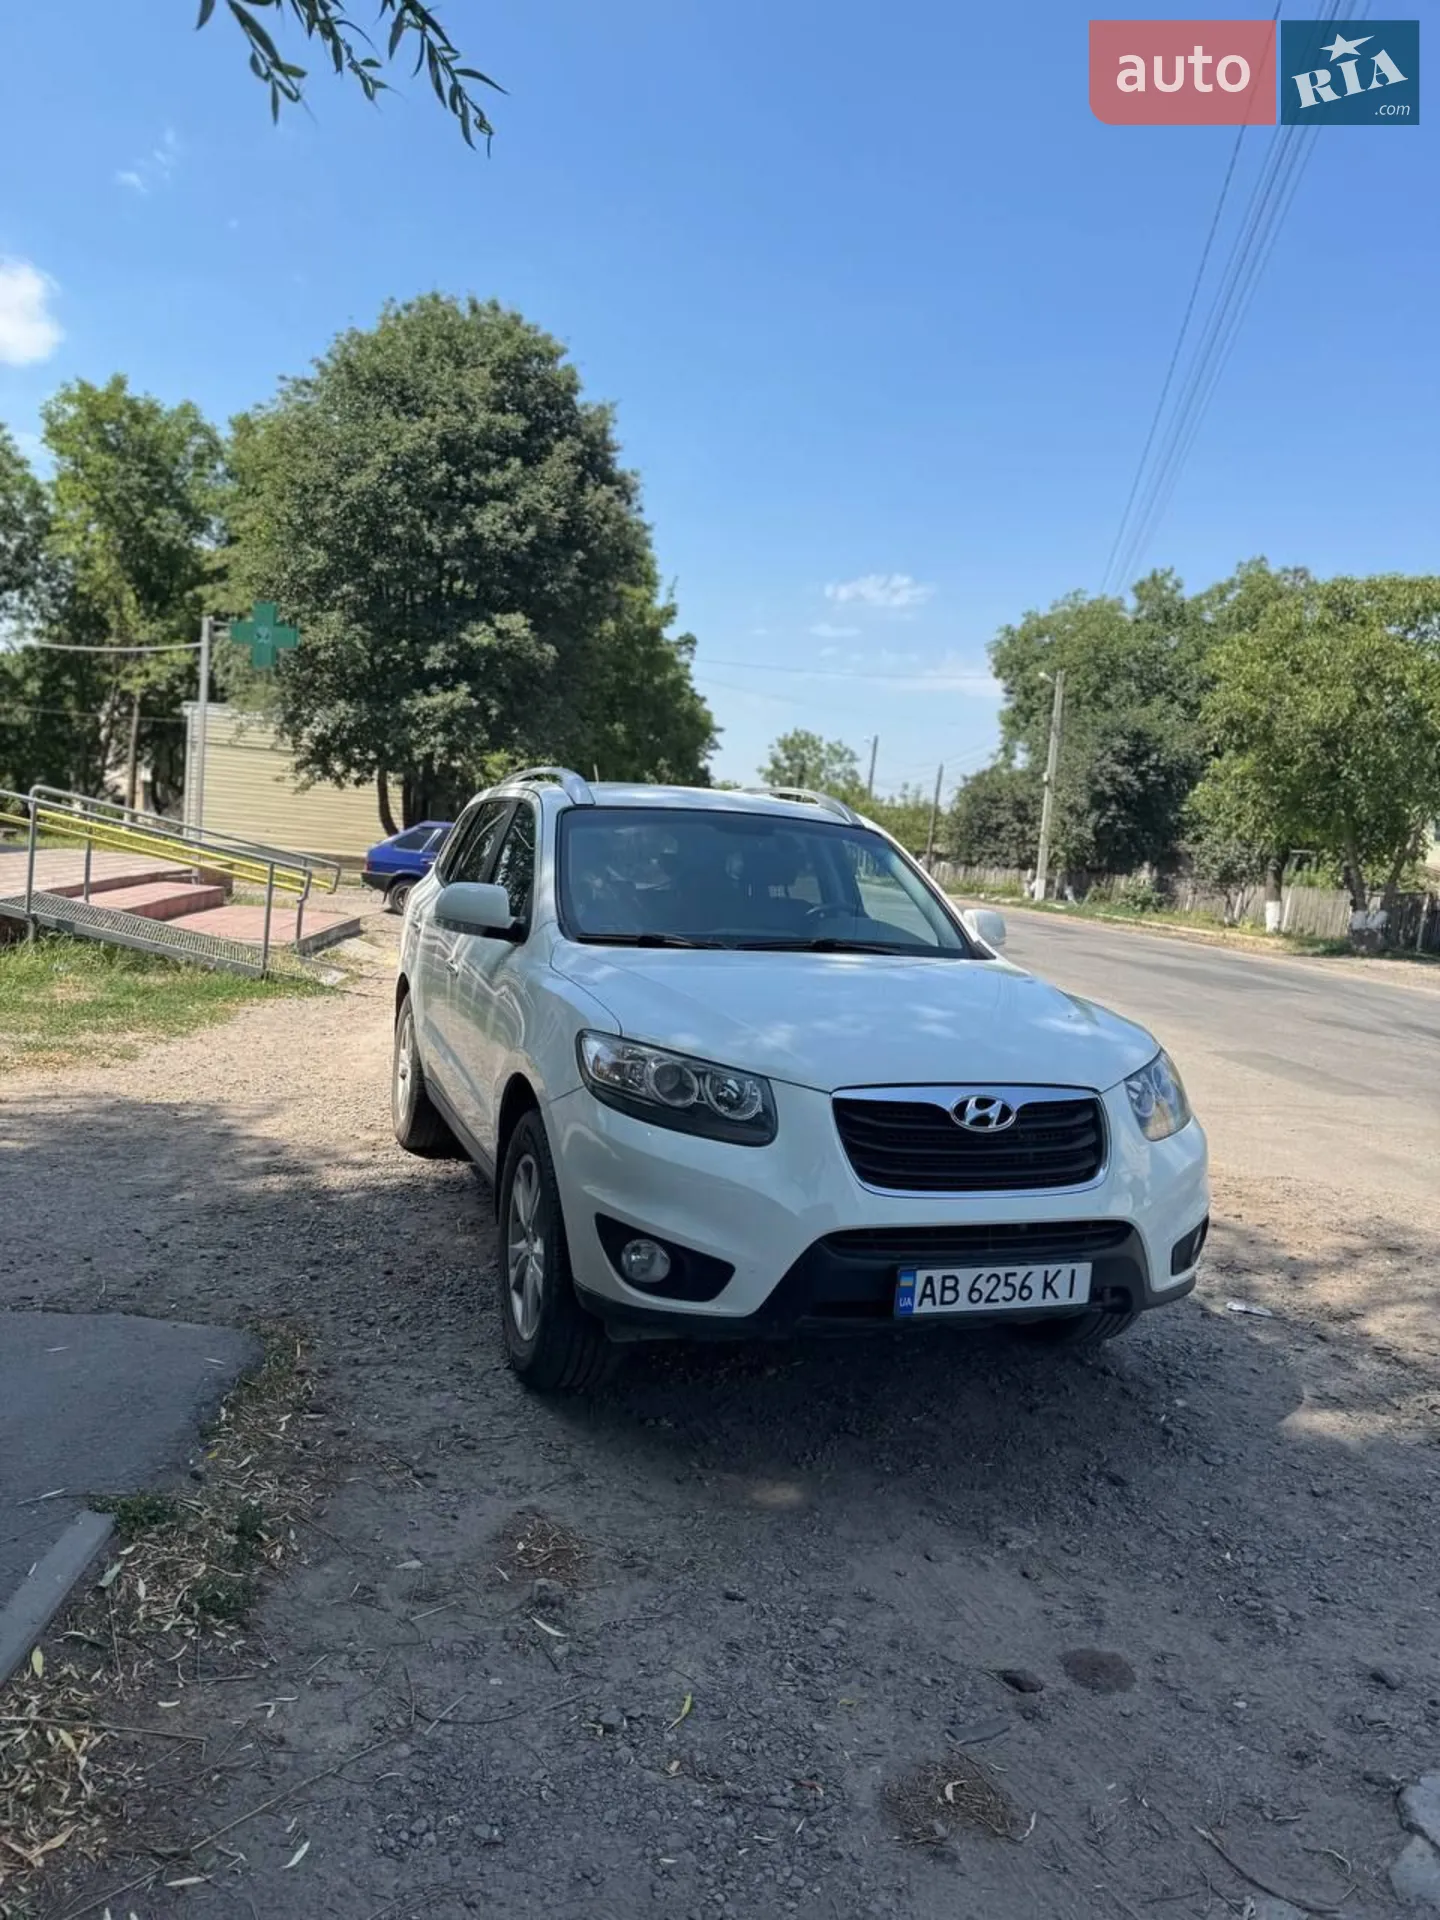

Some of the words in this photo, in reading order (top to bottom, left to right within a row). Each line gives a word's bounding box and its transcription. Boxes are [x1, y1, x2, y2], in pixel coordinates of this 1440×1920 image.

[918, 1274, 960, 1307] AB
[967, 1271, 1034, 1304] 6256
[1042, 1268, 1076, 1300] KI
[899, 1298, 913, 1307] UA
